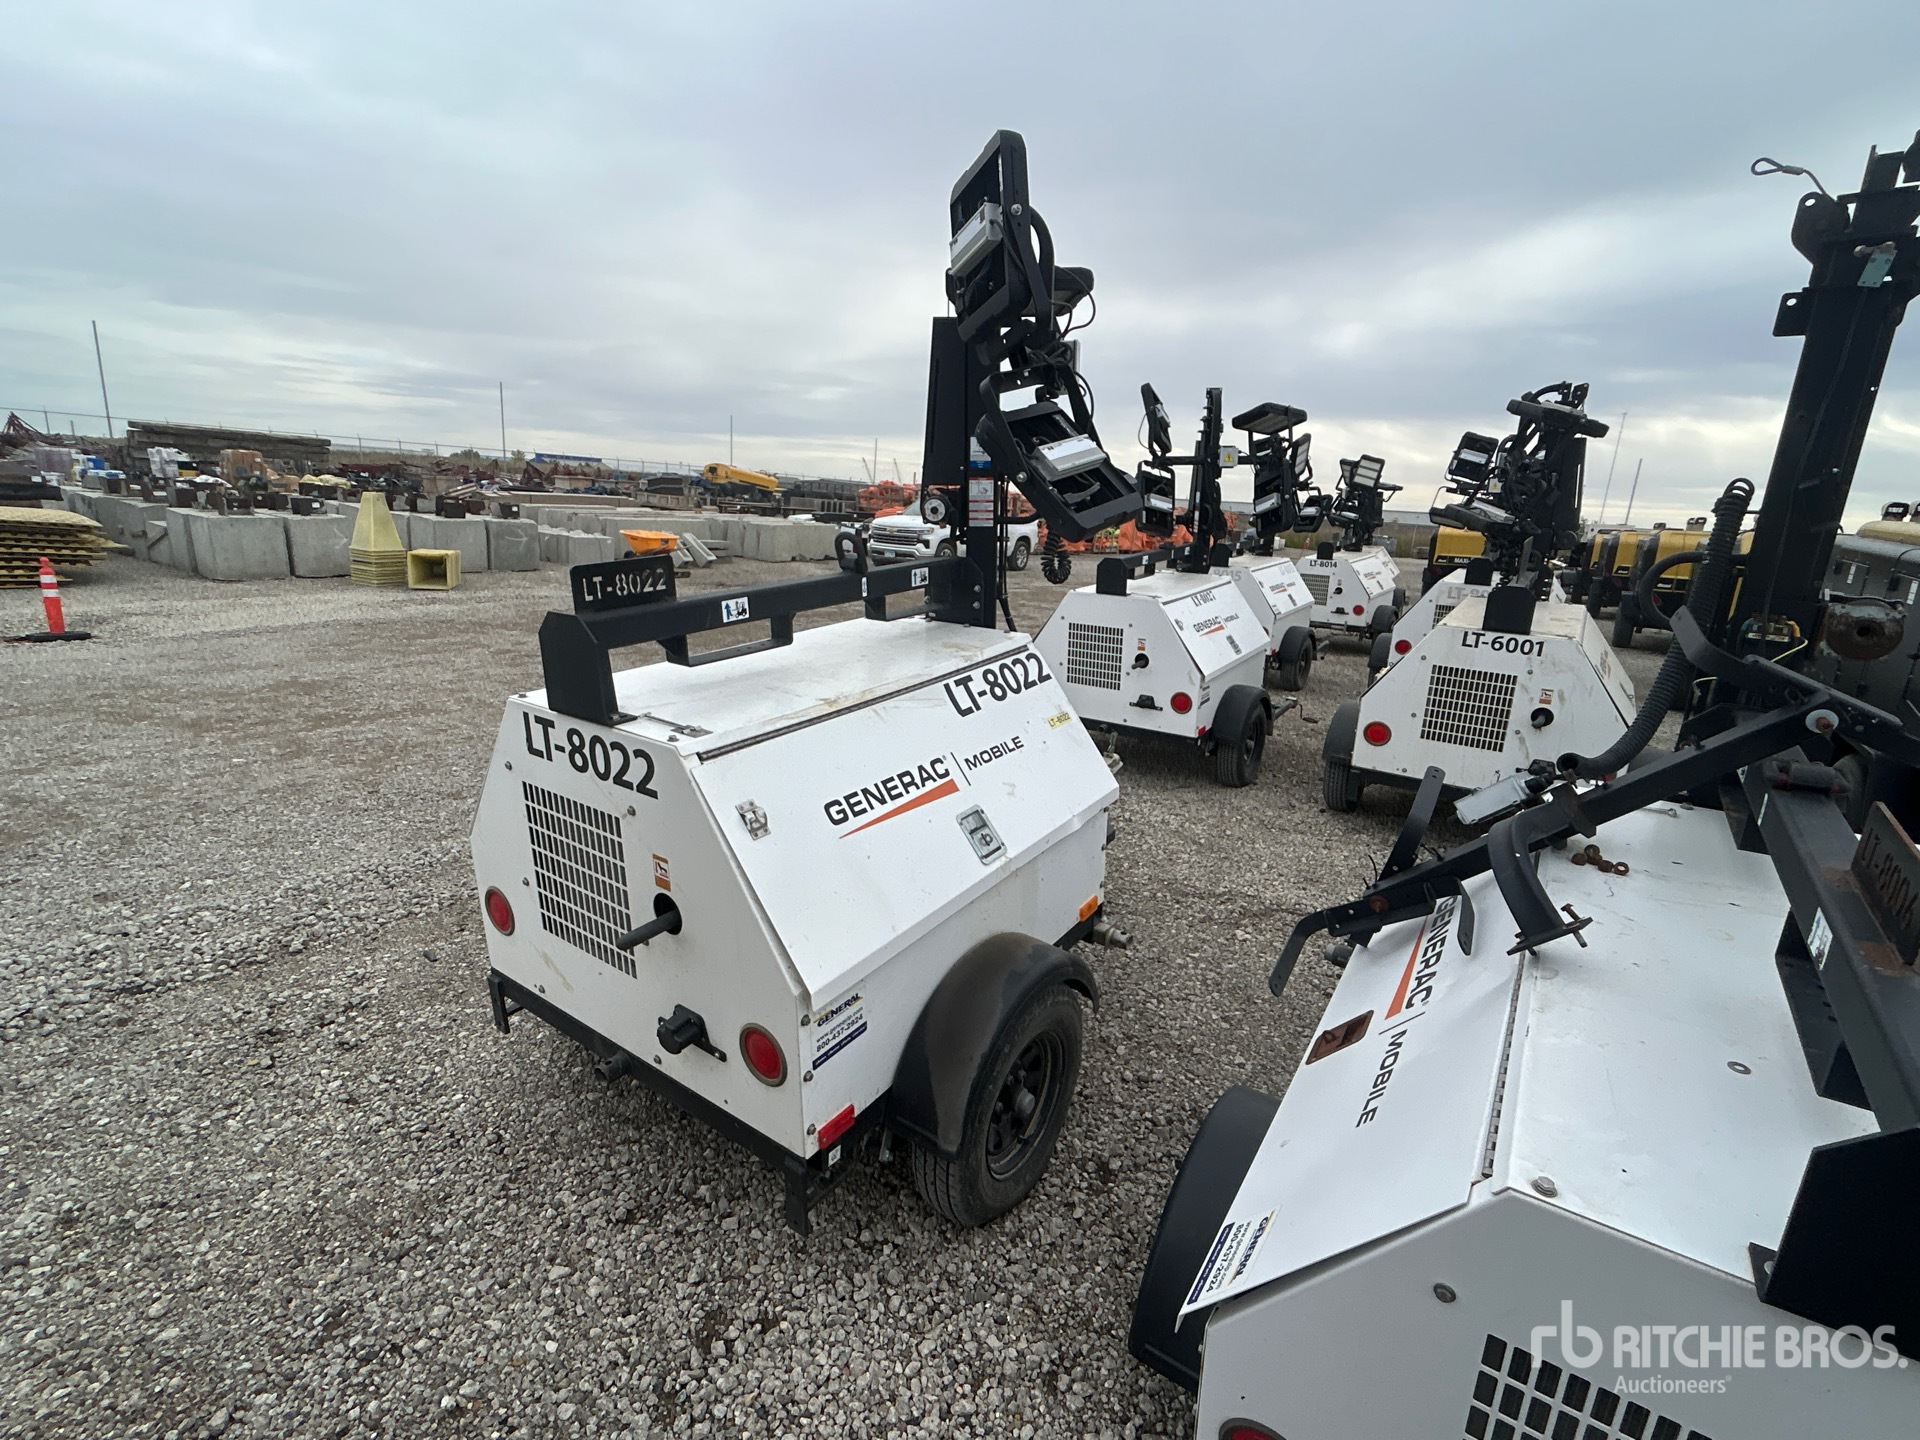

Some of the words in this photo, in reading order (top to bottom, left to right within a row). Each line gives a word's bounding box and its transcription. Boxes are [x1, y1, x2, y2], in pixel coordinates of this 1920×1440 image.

[583, 567, 667, 602] LT-8022
[1309, 560, 1338, 569] LT-8014
[1193, 616, 1222, 633] GENERAC
[1461, 631, 1545, 657] LT-6001
[943, 652, 1053, 718] LT-8022
[522, 711, 659, 800] LT-8022
[824, 757, 950, 826] GENERAC
[964, 736, 1025, 771] MOBILE
[1405, 895, 1458, 1010] GENERAC
[816, 1013, 863, 1052] 800-437-2924
[817, 993, 861, 1027] GENERAL
[1355, 1029, 1407, 1128] MOBILE
[1206, 1223, 1244, 1292] 800-437-2924
[1235, 1216, 1269, 1277] GENERAL
